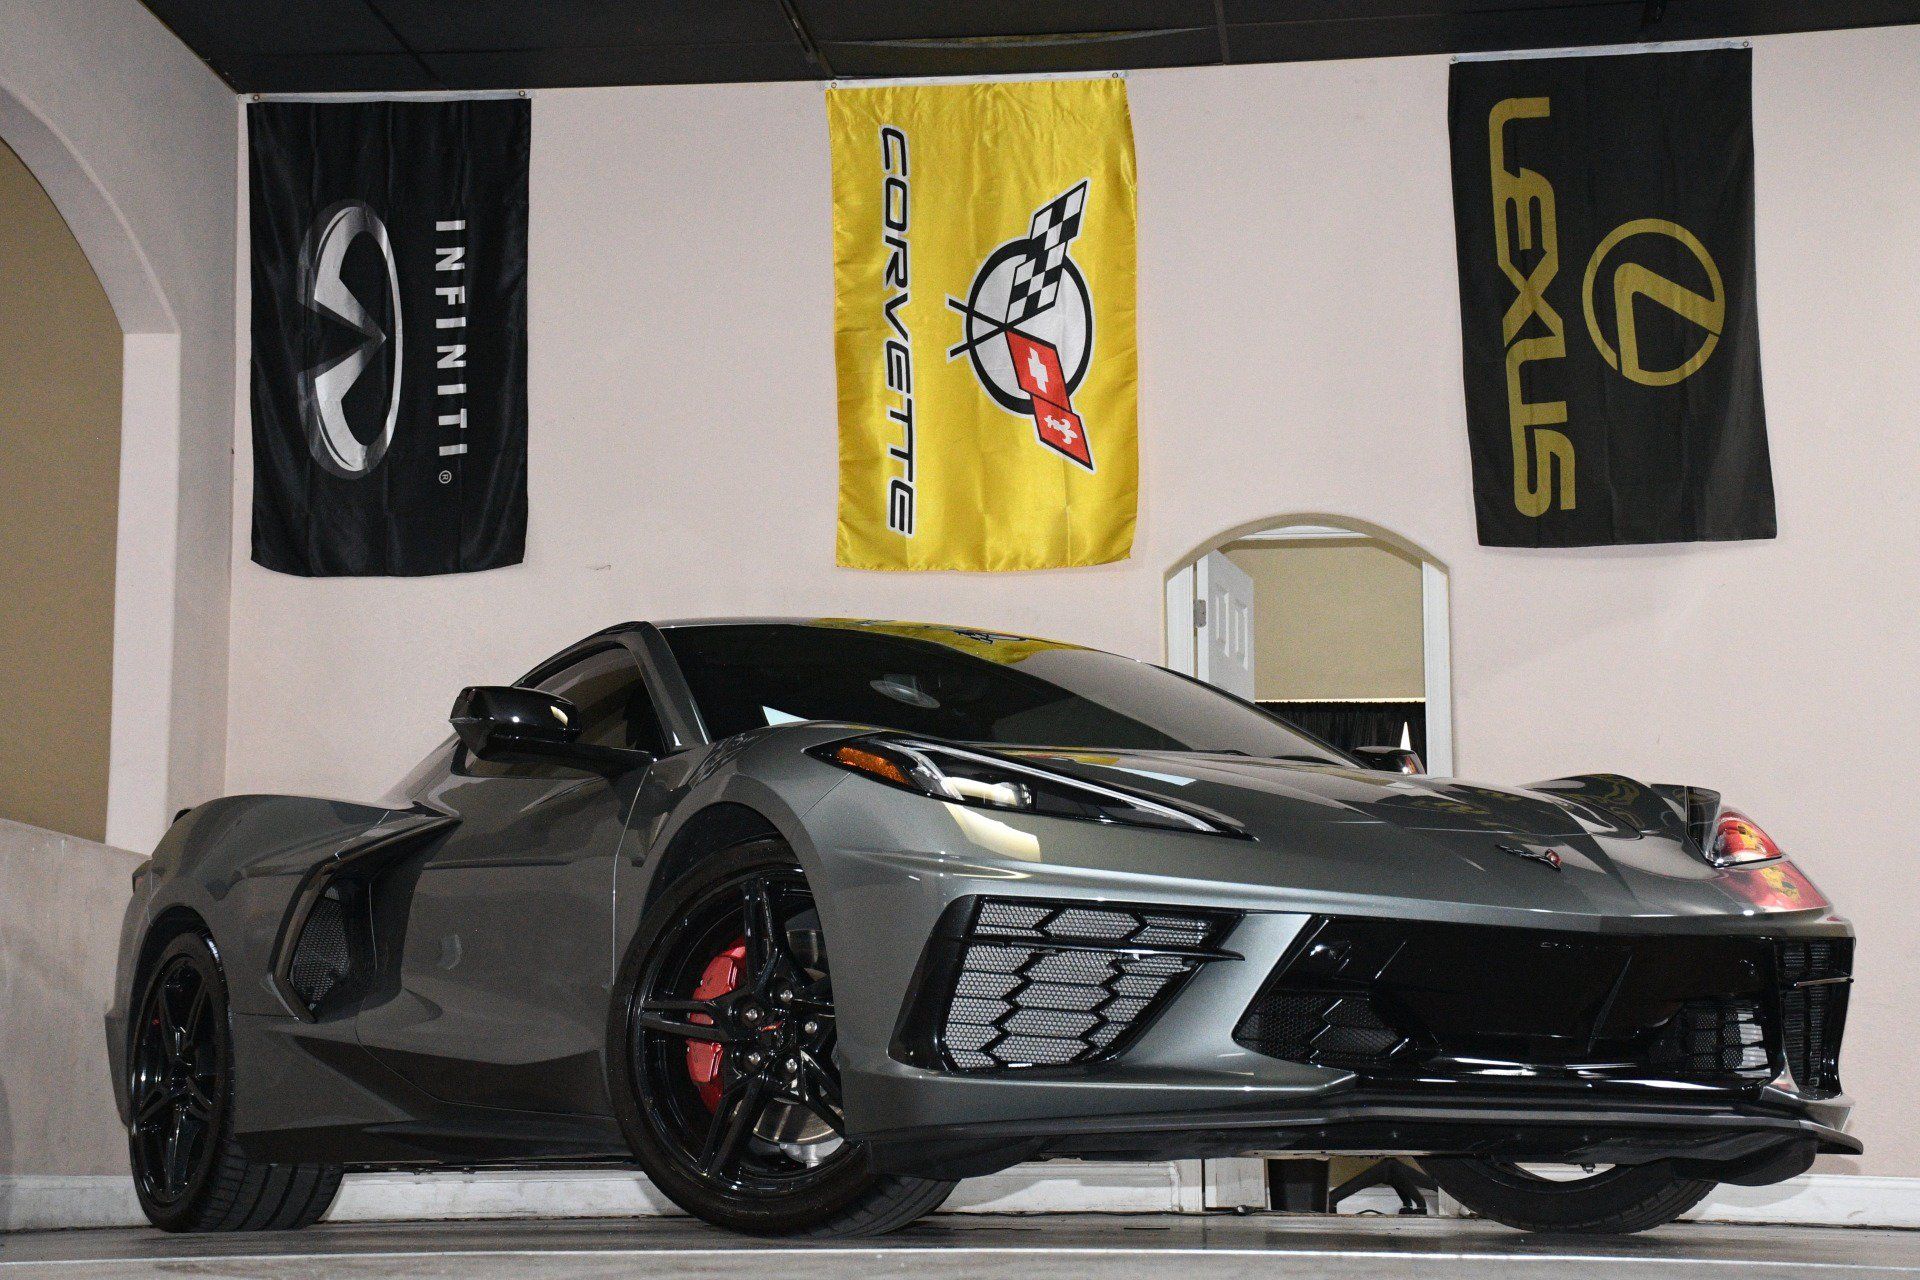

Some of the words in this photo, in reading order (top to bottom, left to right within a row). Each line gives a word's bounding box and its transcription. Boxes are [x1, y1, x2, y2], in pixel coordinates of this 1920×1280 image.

[435, 219, 468, 456] INFINITI
[882, 126, 914, 536] CORVETTE
[1489, 97, 1576, 518] LEXUS
